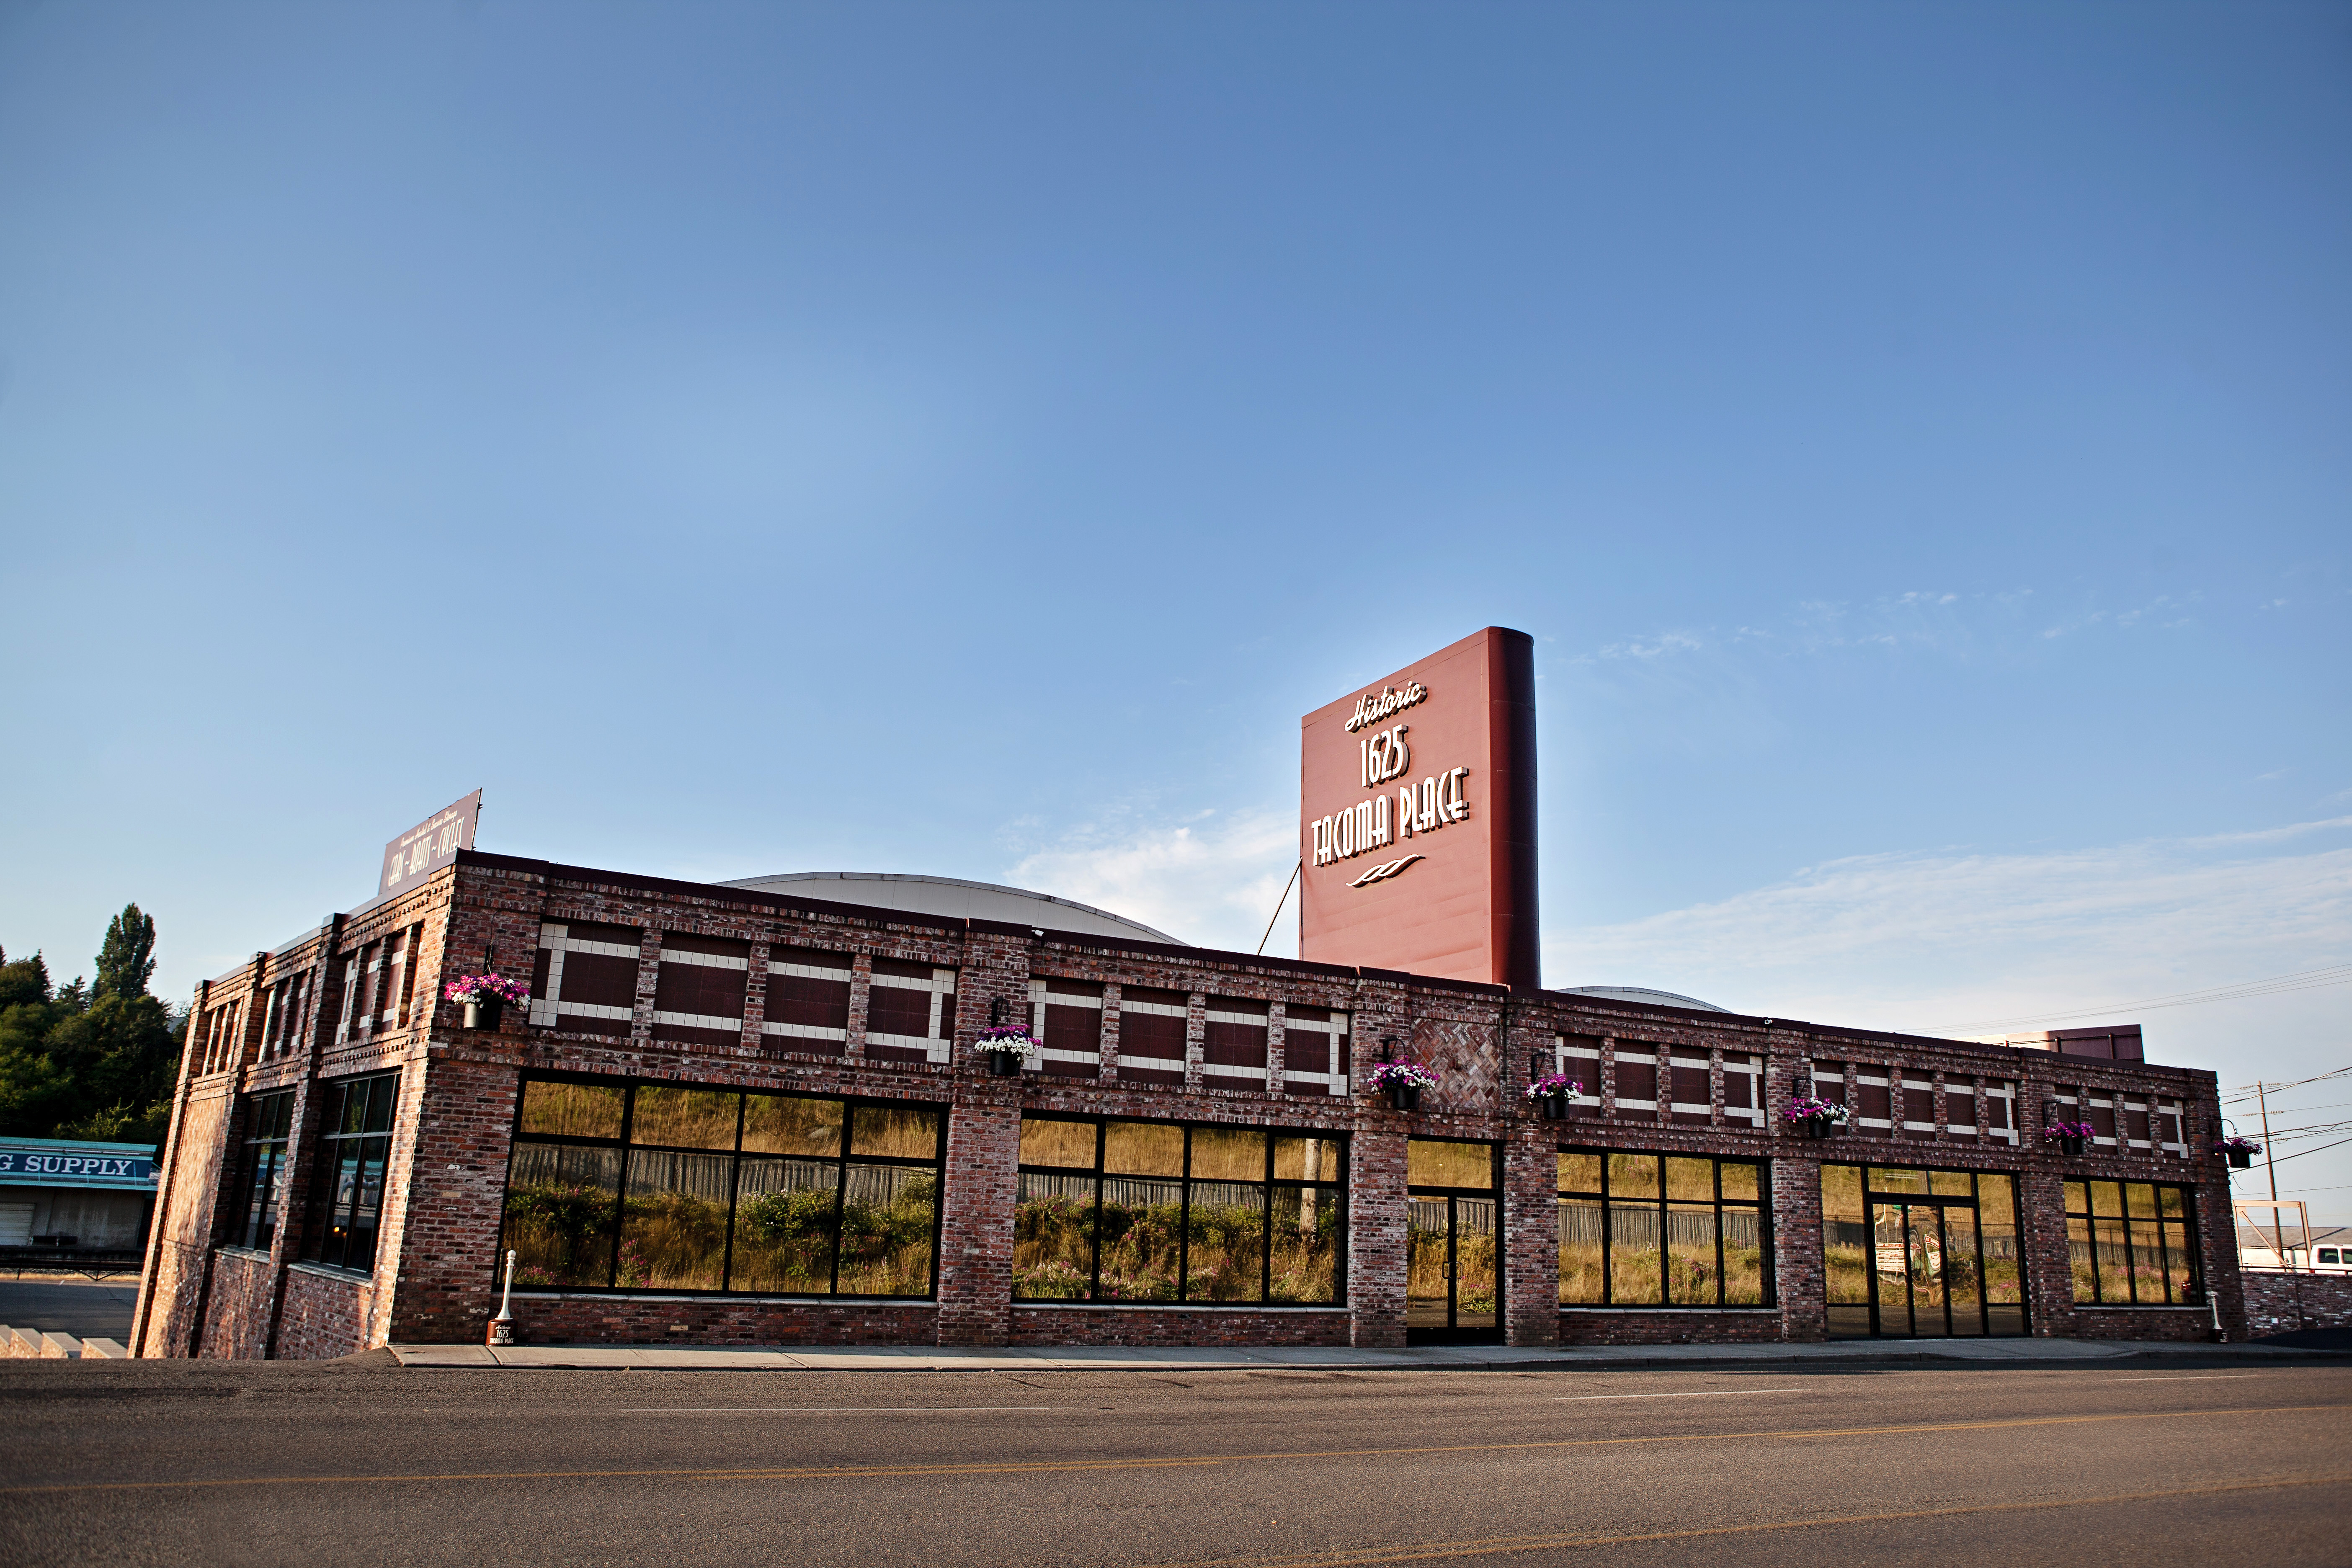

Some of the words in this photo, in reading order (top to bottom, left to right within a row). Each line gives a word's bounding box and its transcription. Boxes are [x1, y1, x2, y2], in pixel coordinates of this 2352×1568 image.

[1344, 681, 1425, 732] Historic
[1360, 724, 1406, 788] 1625
[1311, 794, 1391, 867] TACOMA
[1399, 766, 1467, 838] PLACE
[409, 834, 433, 876] BOATS
[25, 1155, 132, 1175] SUPPLY
[497, 1329, 509, 1338] 1625
